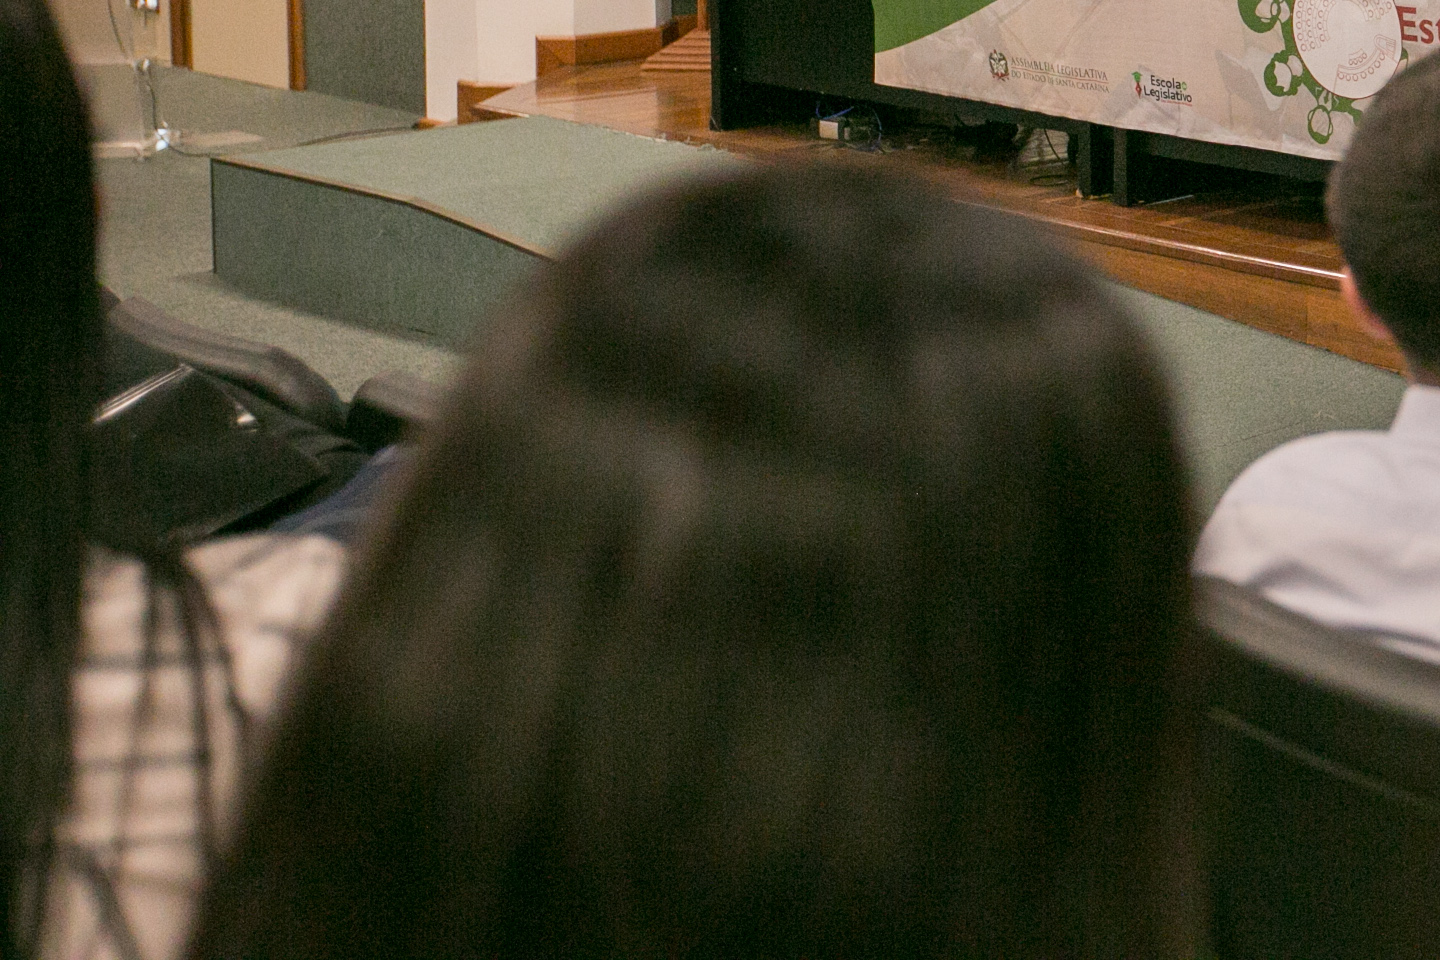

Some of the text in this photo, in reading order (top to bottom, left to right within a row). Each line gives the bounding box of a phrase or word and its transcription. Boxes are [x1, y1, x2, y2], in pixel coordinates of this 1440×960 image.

[1010, 56, 1109, 82] ASSEMBLEIA LEGISLATIVA
[1055, 77, 1076, 89] SANTA
[1076, 81, 1111, 94] CATARINA
[1150, 74, 1181, 90] Escola
[1143, 85, 1193, 103] Legislativo
